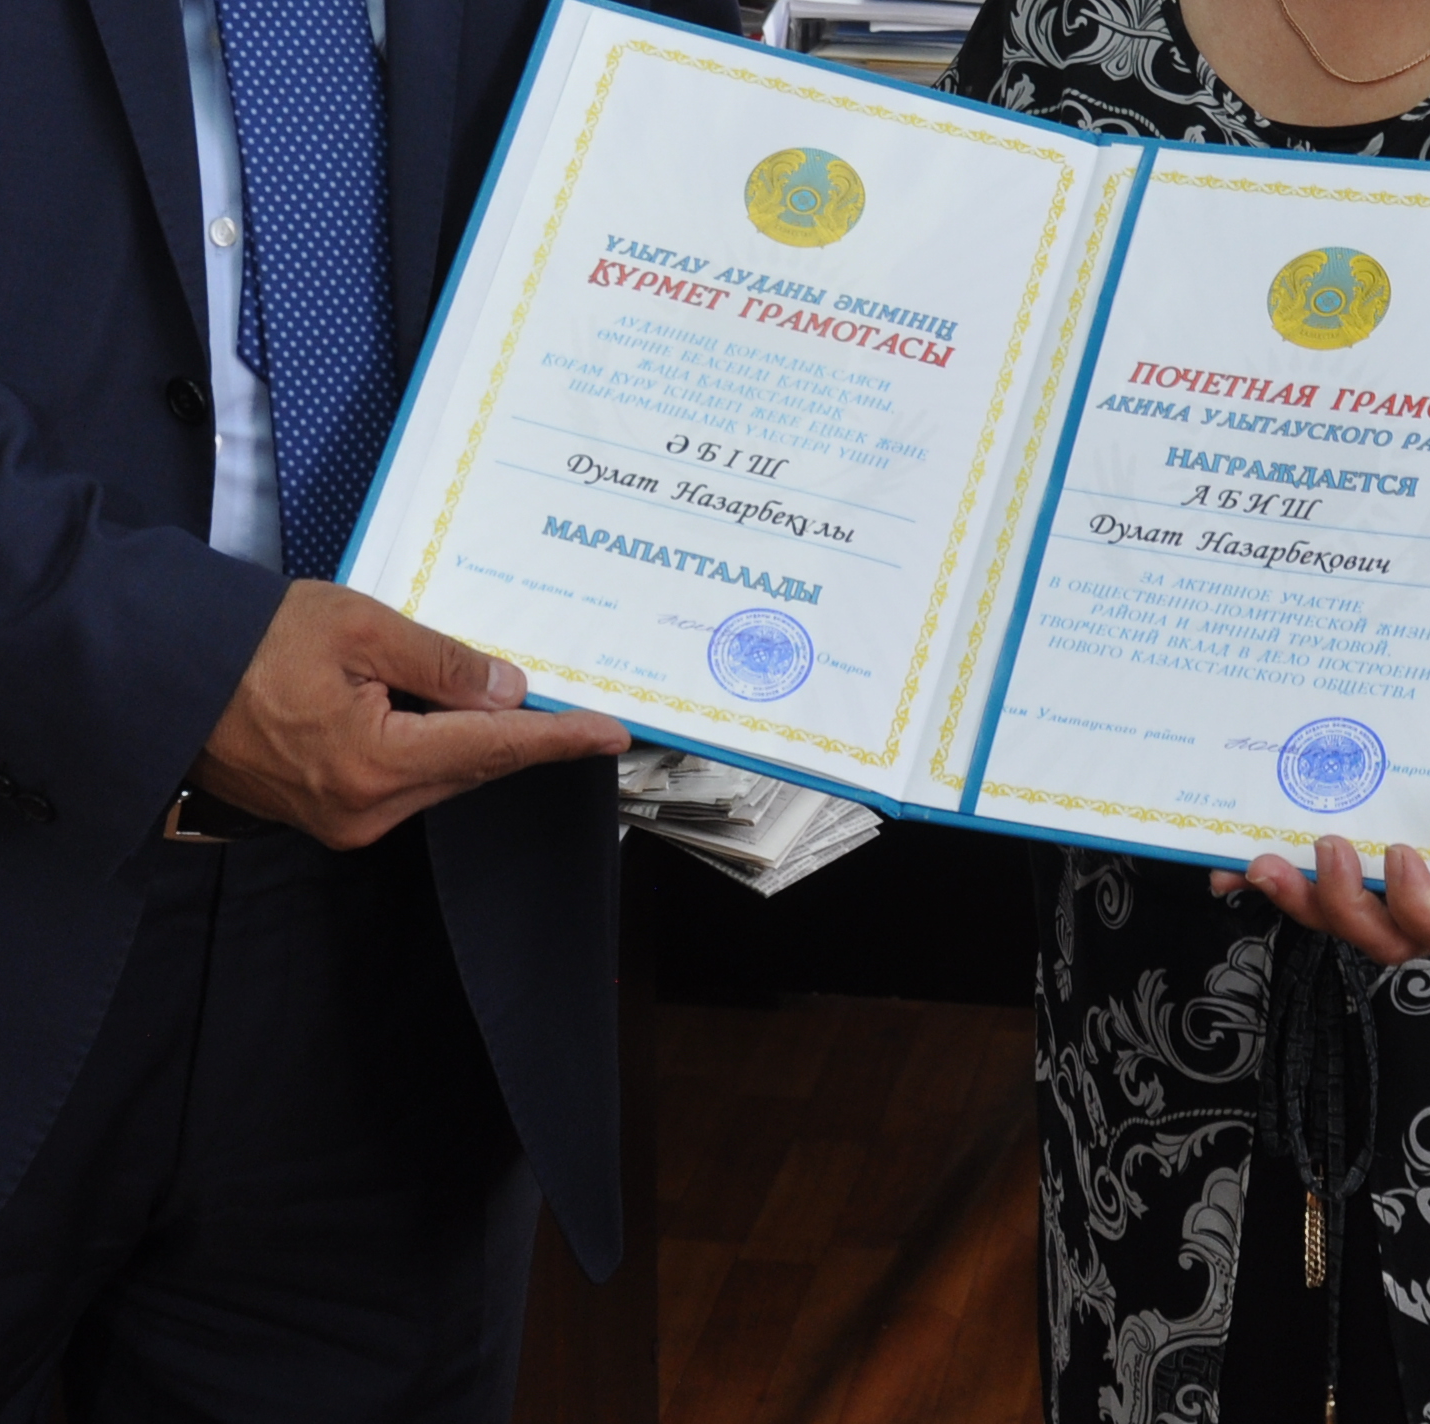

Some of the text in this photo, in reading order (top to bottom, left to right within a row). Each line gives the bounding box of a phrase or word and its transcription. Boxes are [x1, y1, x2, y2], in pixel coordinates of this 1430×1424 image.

[588, 258, 956, 367] ҚҰРМЕТ ГРАМОТАСЫ
[714, 267, 827, 305] АУДАНЫ
[834, 294, 958, 341] ӘКІМІНІҢ
[681, 349, 770, 382] БЕЛСЕНДІ
[1128, 361, 1320, 408] ПОЧЕТНАЯ
[750, 406, 801, 428] ЖЕКЕ
[809, 421, 868, 445] ЕҢБЕК
[875, 437, 930, 461] ЖӘНЕ
[1096, 394, 1191, 423] АКИМА
[1200, 407, 1394, 448] УЛЫТАУСКОГО
[566, 453, 659, 494] Дулат
[1165, 446, 1420, 498] НАГРАЖДАЕТСЯ
[541, 515, 823, 606] МАРАПАТТАЛАДЫ
[1089, 514, 1392, 575] Дулат Назарбекович
[522, 577, 574, 598] ауданы
[1048, 575, 1061, 589] В
[1068, 579, 1368, 634] ОБЩЕСТВЕННО-ПОЛИТИЧЕСКОЙ
[1139, 571, 1365, 614] ЗА АКТИВНОЕ УЧАСТИЕ
[1038, 613, 1161, 646] ТВОРЧЕСКИЙ
[1166, 635, 1231, 659] ВКЛАД
[1237, 646, 1251, 660] В
[1257, 649, 1311, 668] ДЕЛО
[1090, 603, 1168, 627] РАЙОНА
[1175, 617, 1190, 630] И
[1197, 620, 1282, 644] ЛИЧНЫЙ
[596, 653, 631, 672] 2015
[816, 652, 872, 678] Омаров
[1048, 636, 1417, 701] НОВОГО КАЗАХСТАНСКОГО ОБЩЕСТВА
[1002, 704, 1196, 745] ким Улытауского района
[1175, 789, 1211, 808] 2015
